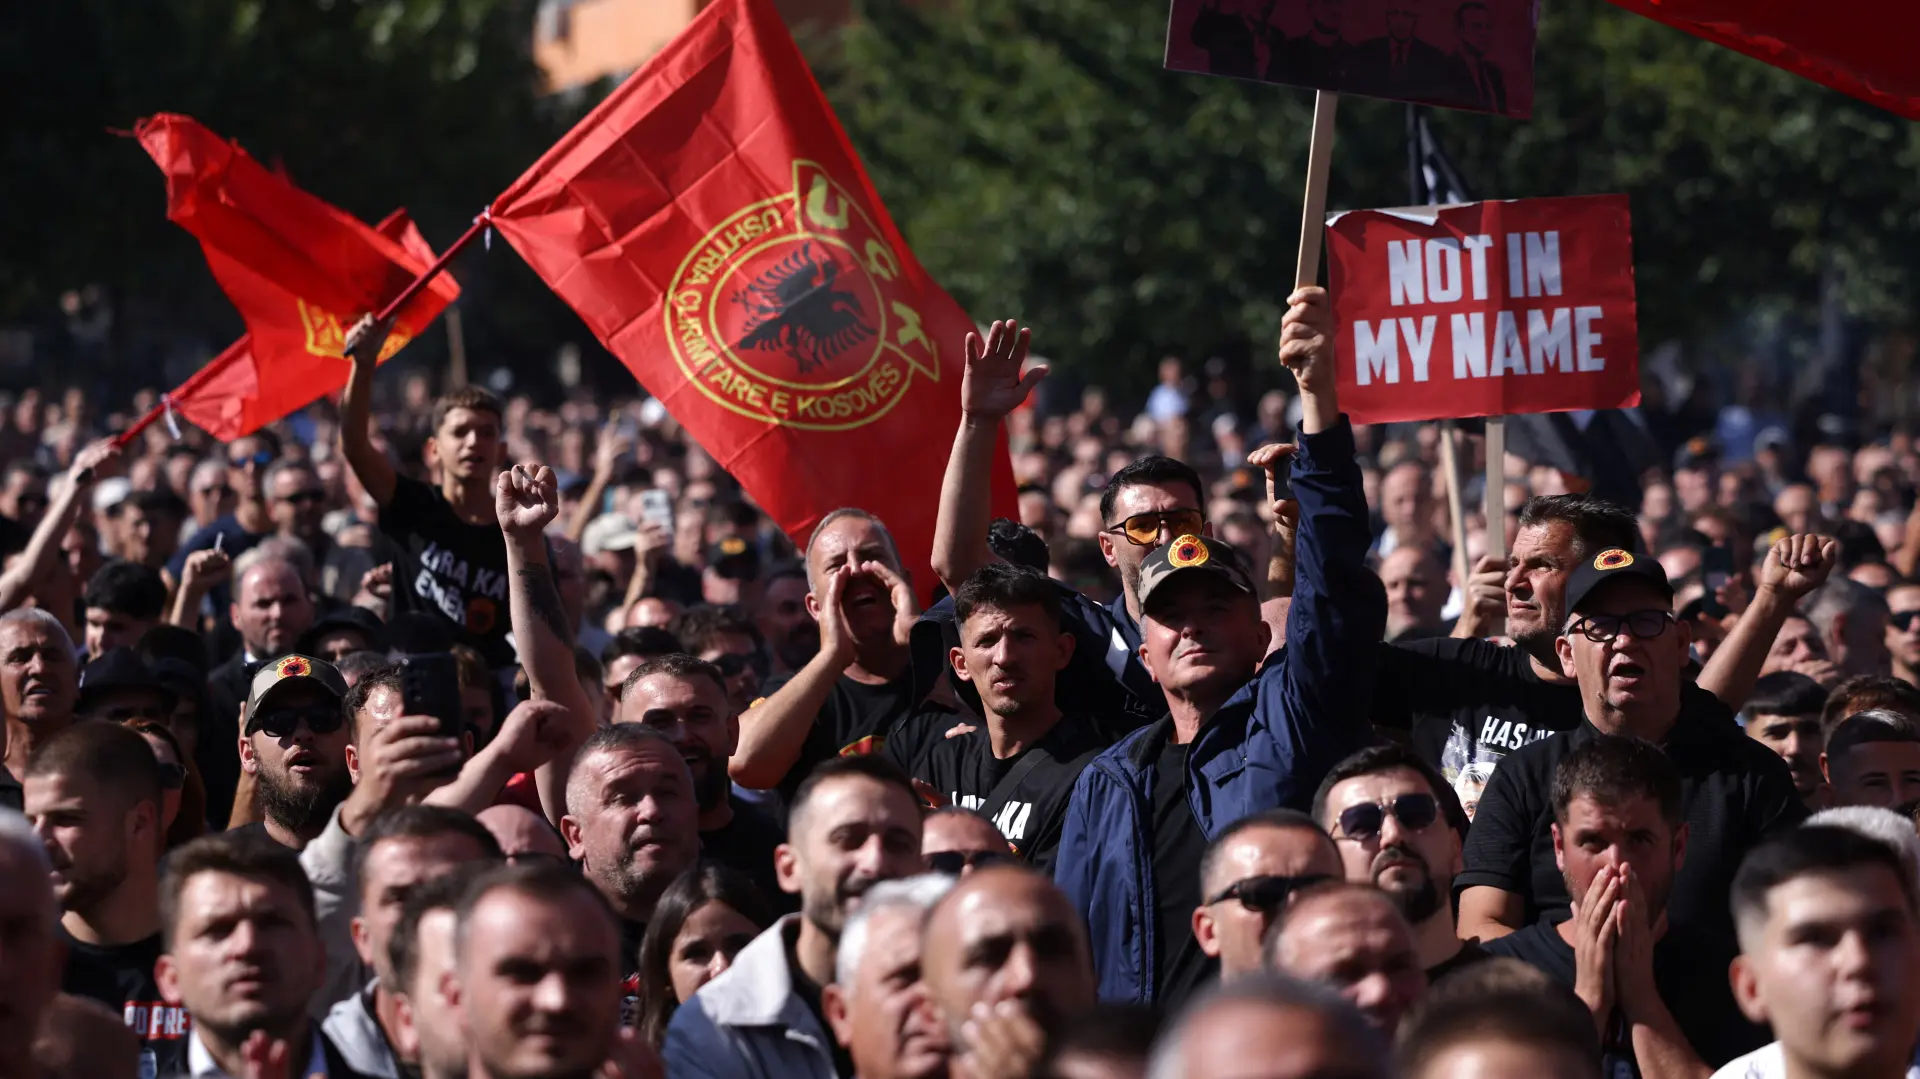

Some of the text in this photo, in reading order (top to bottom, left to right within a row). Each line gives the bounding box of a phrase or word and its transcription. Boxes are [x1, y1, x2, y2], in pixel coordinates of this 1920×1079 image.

[1387, 230, 1562, 306] NOT IN
[684, 207, 784, 285] USHTRIA
[770, 391, 791, 414] E
[796, 361, 901, 418] KOSOVËS
[1353, 305, 1605, 386] MY NAME
